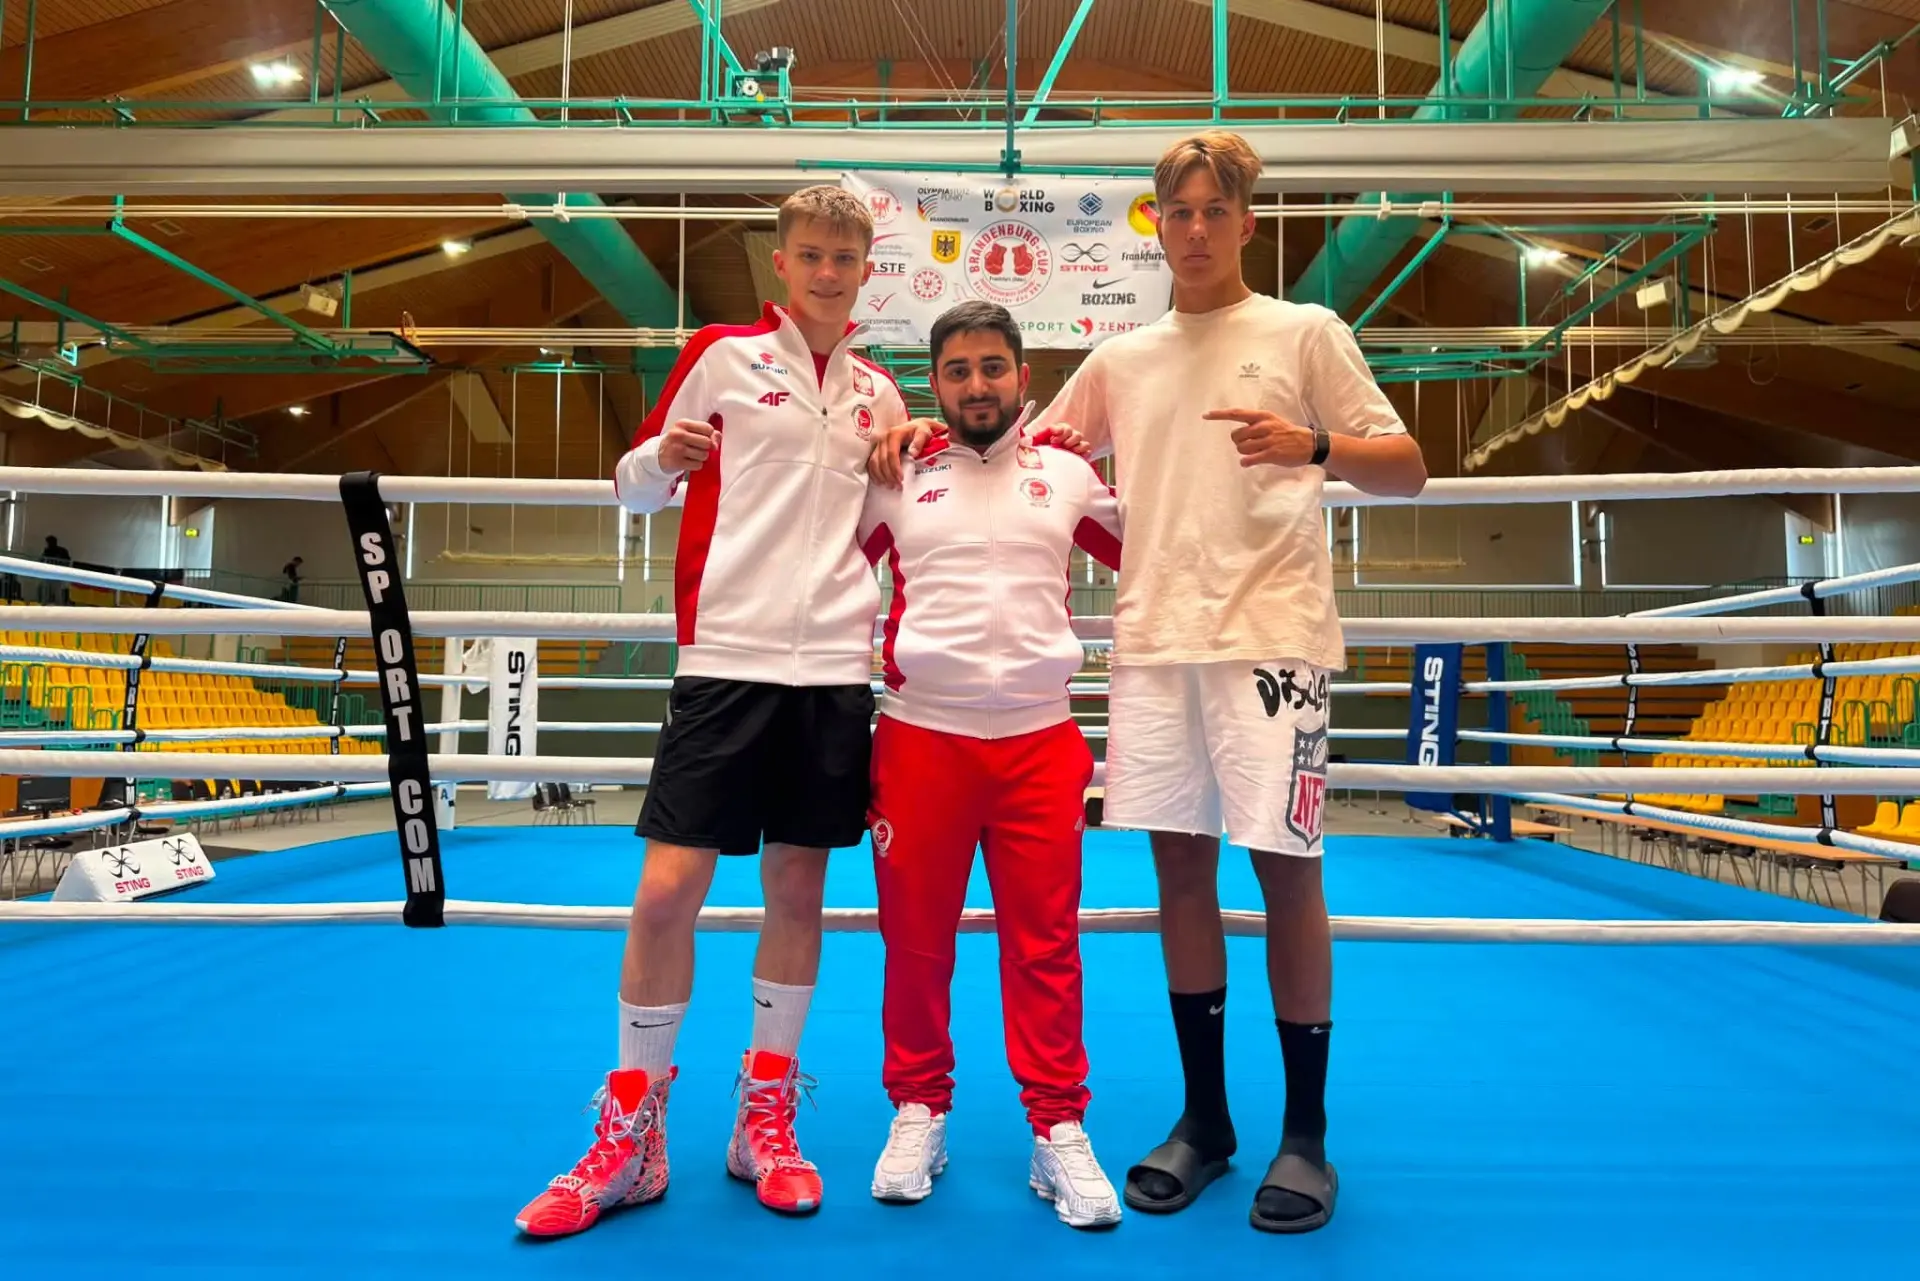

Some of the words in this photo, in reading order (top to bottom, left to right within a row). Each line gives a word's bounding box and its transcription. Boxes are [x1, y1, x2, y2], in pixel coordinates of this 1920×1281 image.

[984, 200, 1056, 213] BOXING
[1066, 219, 1113, 227] EUROPEAN
[872, 262, 906, 274] LSTE
[1060, 264, 1109, 272] STING
[1081, 292, 1137, 306] BOXING
[1019, 321, 1065, 332] SPORT
[1098, 321, 1150, 332] ZENT
[757, 391, 791, 407] 4F
[916, 488, 949, 503] 4F
[505, 650, 526, 757] STING
[1417, 656, 1444, 767] STING
[1293, 773, 1326, 837] NF
[398, 779, 436, 893] COM
[174, 865, 205, 880] STING
[115, 877, 152, 894] STING
